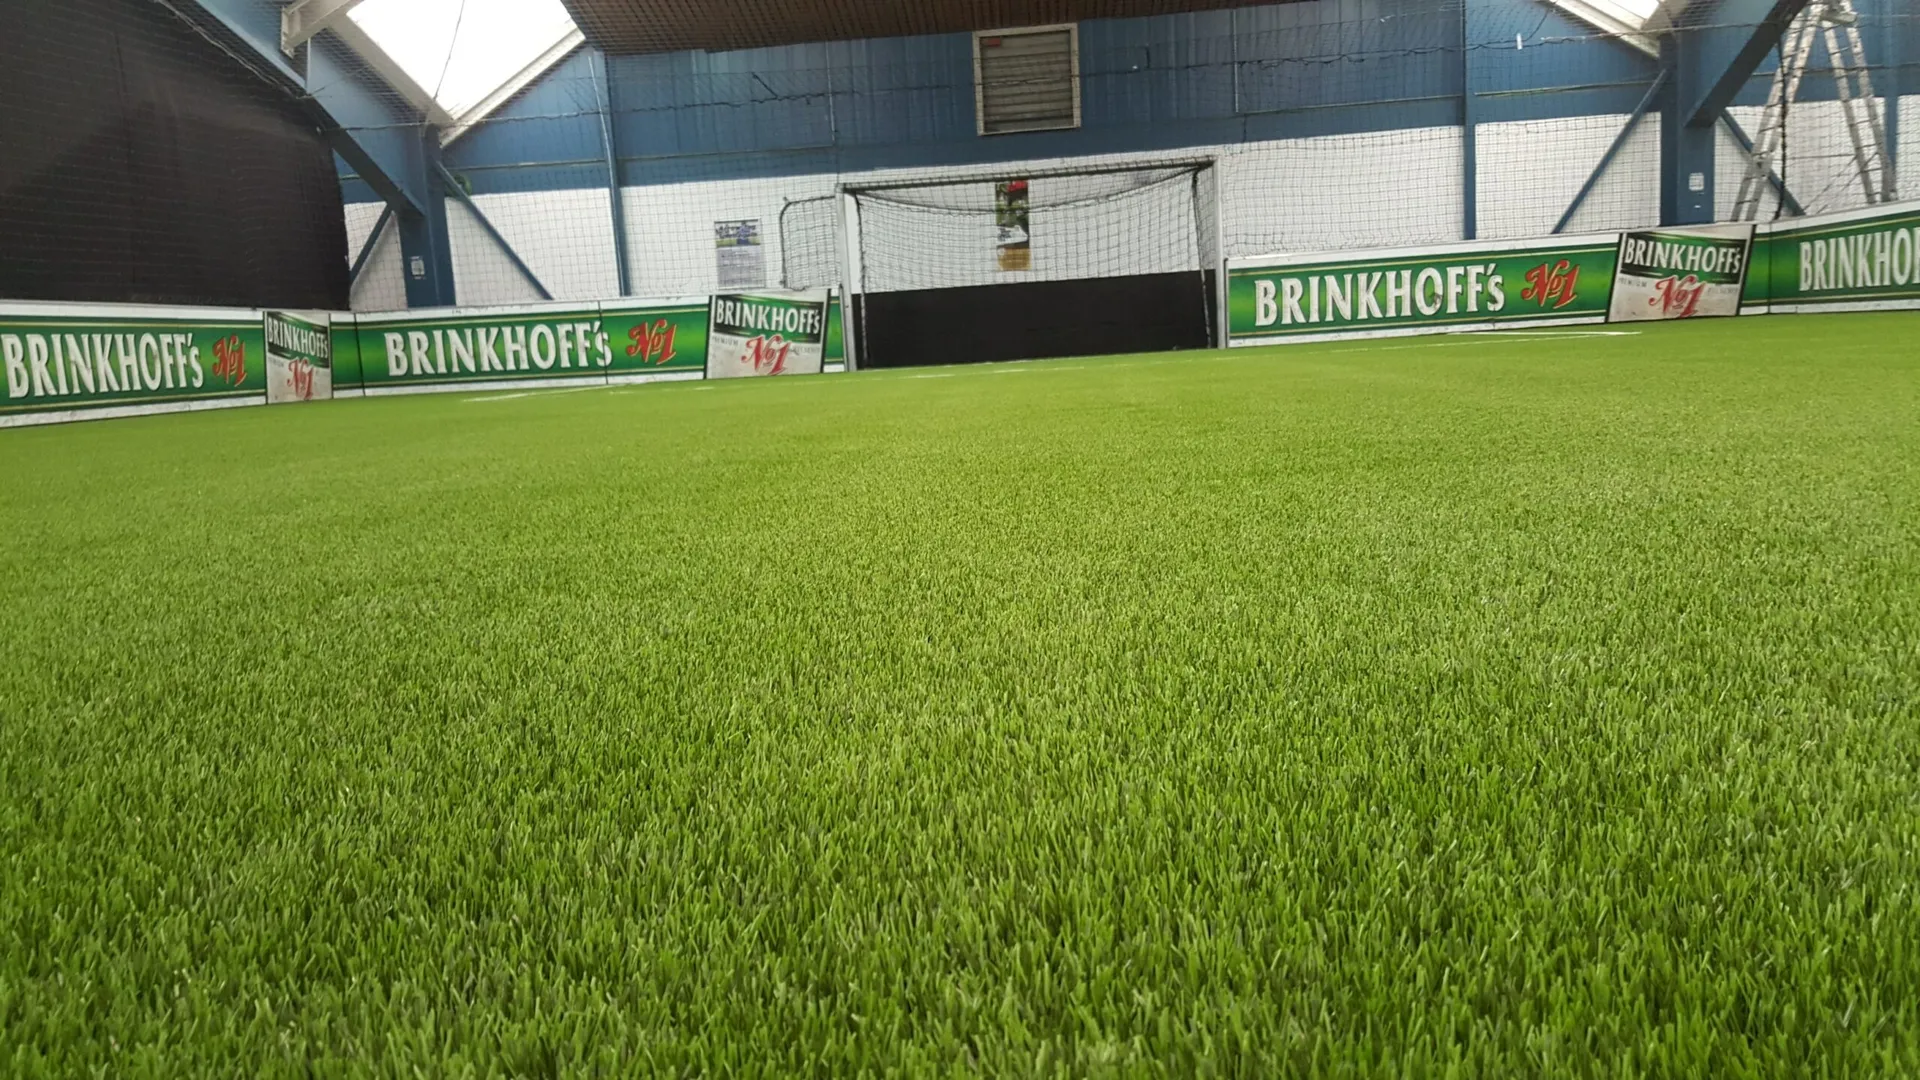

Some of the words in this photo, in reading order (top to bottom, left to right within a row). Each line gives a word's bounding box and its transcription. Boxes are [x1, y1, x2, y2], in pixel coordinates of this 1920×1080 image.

[1624, 237, 1741, 273] BRINKHOFF's
[716, 298, 820, 334] BRINKHOFF's
[1254, 263, 1504, 326] BRINKHOFF's
[1, 332, 204, 398] BRINKHOFF's
[384, 320, 612, 377] BRINKHOFF's
